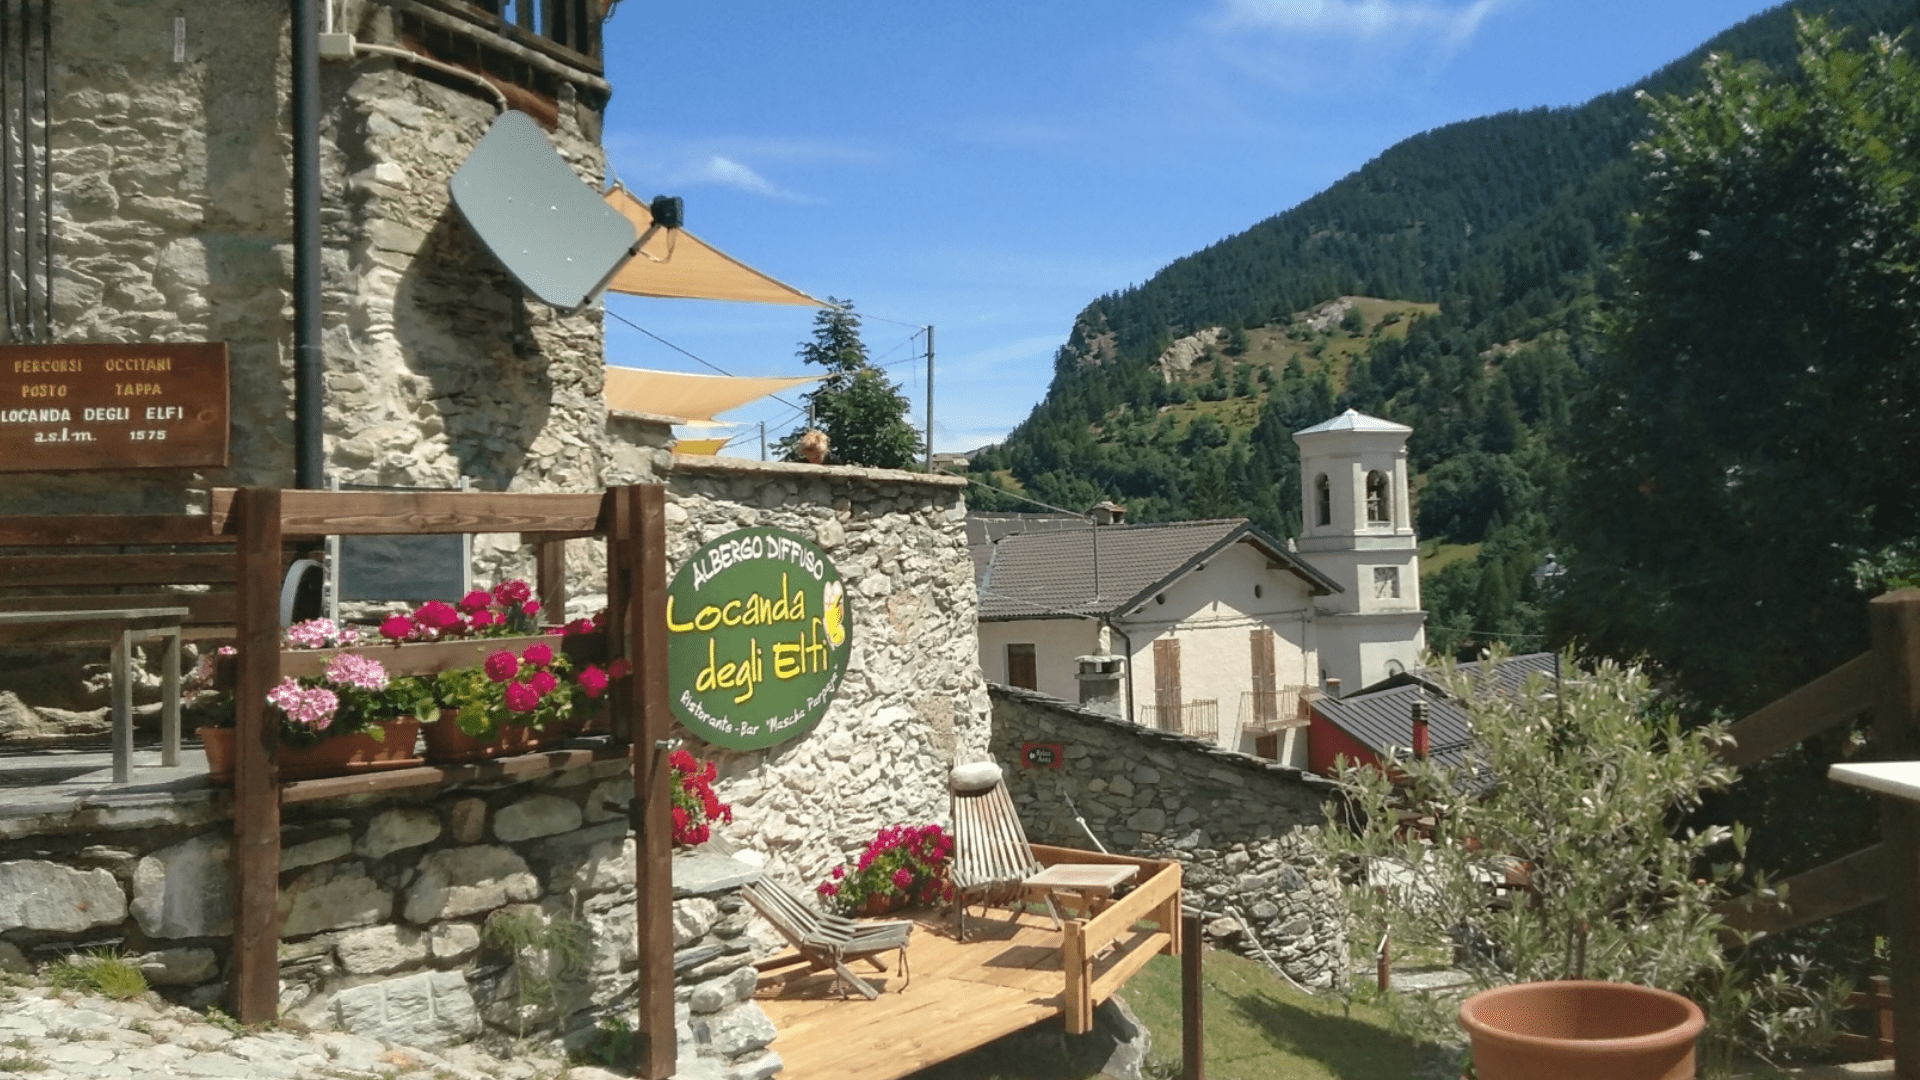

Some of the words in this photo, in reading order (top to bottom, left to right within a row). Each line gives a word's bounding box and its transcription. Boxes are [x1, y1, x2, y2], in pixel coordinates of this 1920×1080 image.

[14, 359, 83, 374] PERCORSI
[105, 357, 172, 372] OCCITANI
[21, 384, 68, 398] POSTO
[115, 383, 162, 396] TAPPA
[1, 408, 71, 423] LOCANDA
[84, 407, 130, 421] DEGLI
[146, 406, 183, 420] ELFI
[130, 430, 167, 440] 1575
[693, 536, 763, 591] ALBERGO
[766, 534, 824, 580] DIFFUSO
[666, 572, 805, 632] Locanda
[696, 637, 763, 704] degli
[773, 617, 828, 679] Elfi
